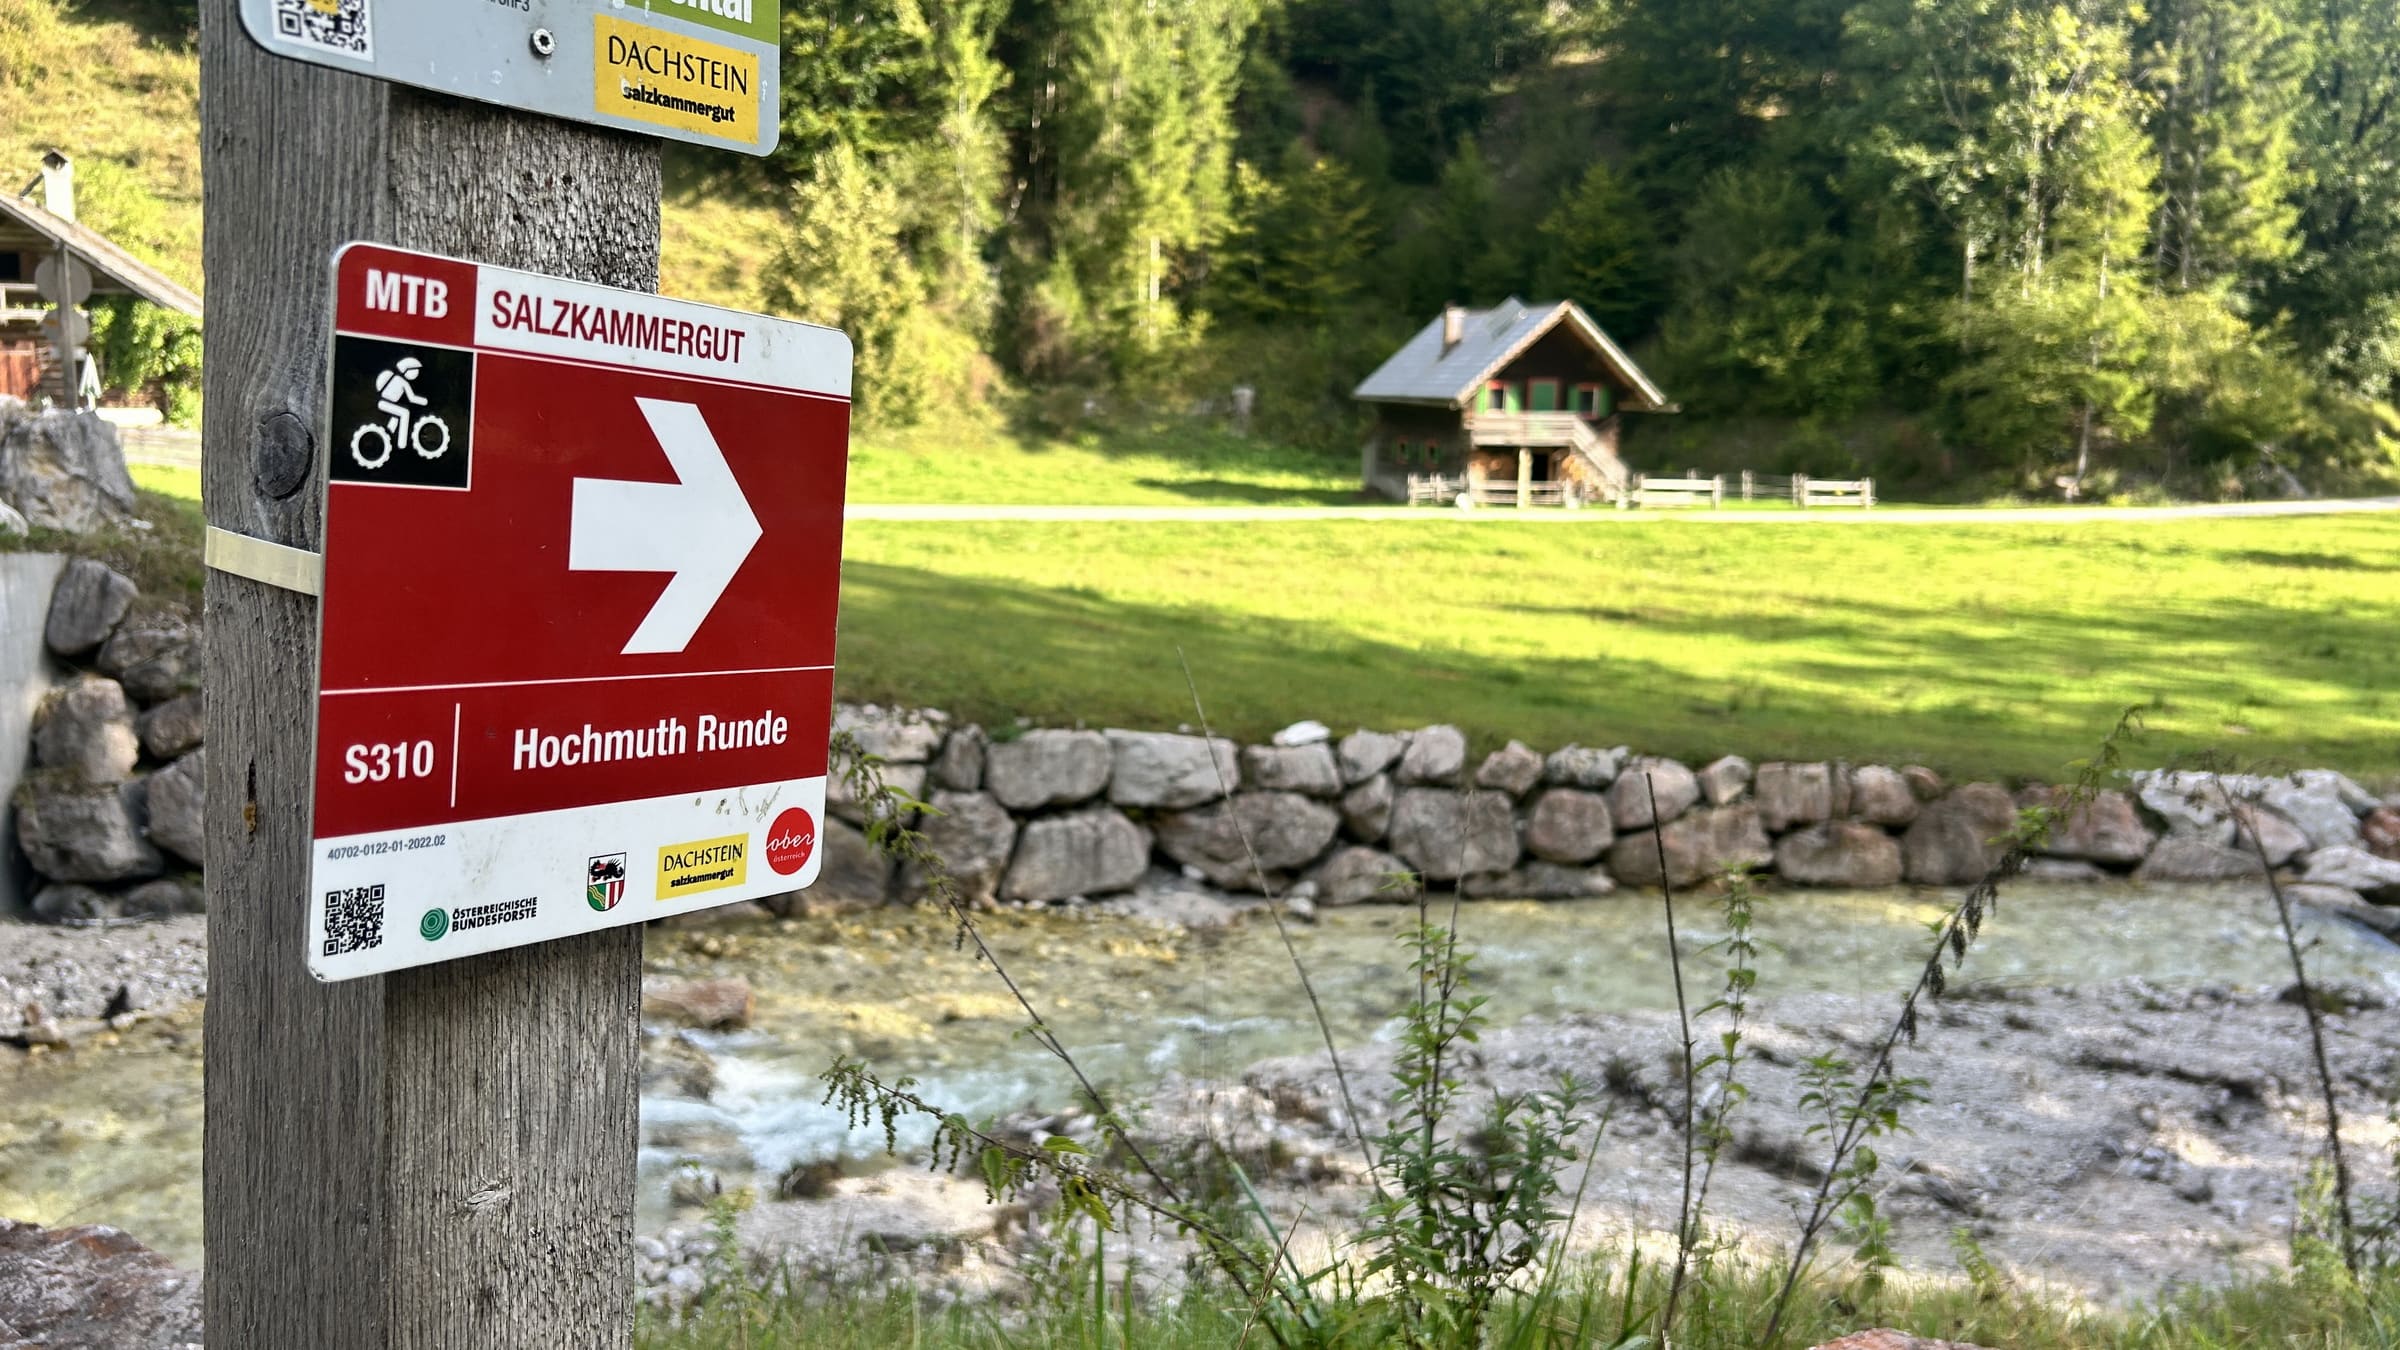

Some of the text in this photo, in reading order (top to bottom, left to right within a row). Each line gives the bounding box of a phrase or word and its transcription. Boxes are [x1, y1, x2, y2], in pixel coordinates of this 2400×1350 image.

[670, 0, 753, 24] tal
[608, 34, 748, 95] DACHSTEIN
[622, 84, 736, 123] salzkammergut
[365, 269, 449, 319] MTB
[491, 289, 746, 364] SALZKAMMERGUT
[512, 709, 788, 771] Hochmuth Runde
[343, 739, 435, 785] S310
[327, 834, 447, 861] 40702-0122-01-2022.02
[765, 828, 816, 852] ober
[663, 843, 744, 872] DACHSTEIN
[670, 866, 735, 888] salzkammergut
[451, 907, 538, 933] BUNDESFORSTE
[452, 896, 538, 920] ÖSTERREICHISCHE
